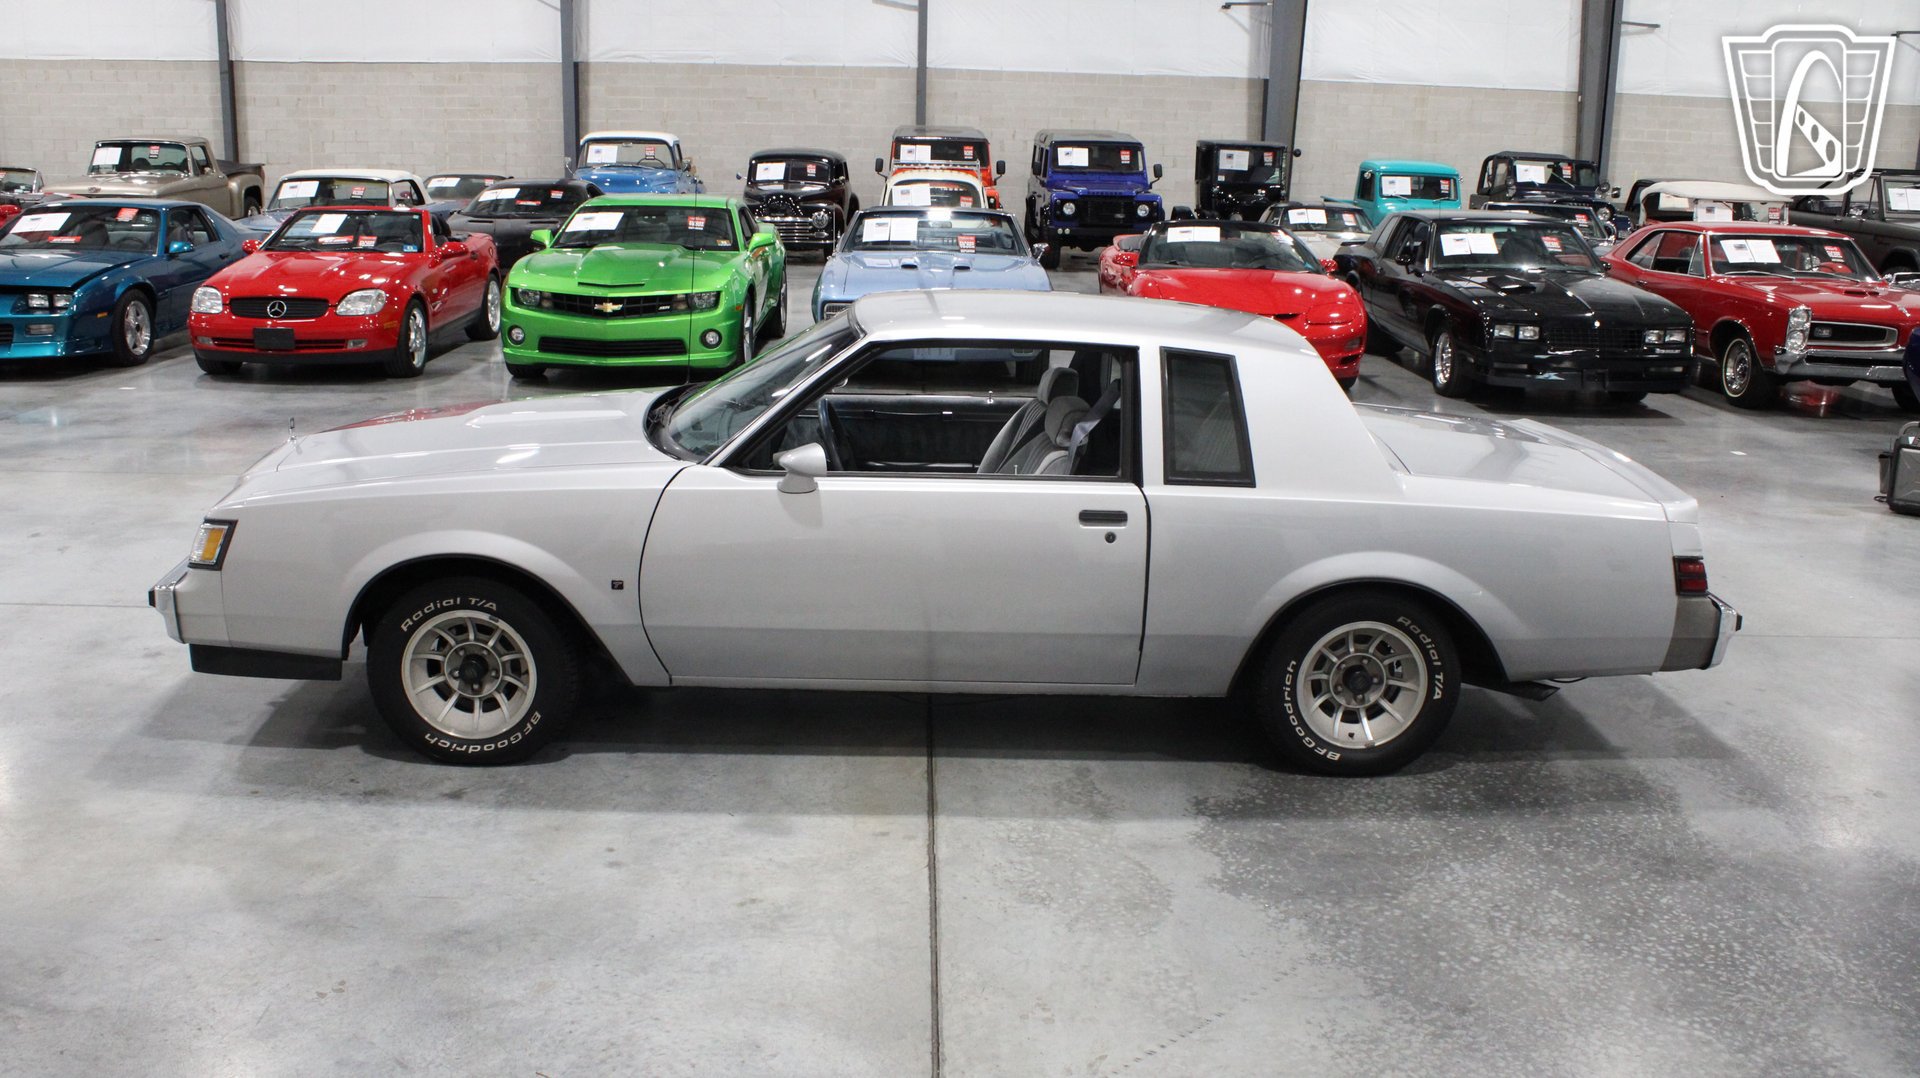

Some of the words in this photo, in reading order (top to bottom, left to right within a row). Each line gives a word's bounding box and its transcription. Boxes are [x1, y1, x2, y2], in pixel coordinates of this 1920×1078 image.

[400, 597, 460, 632] Radial
[468, 597, 498, 611] T/A
[1396, 615, 1442, 666] Radial
[1432, 672, 1444, 700] T/A
[424, 711, 541, 754] BFGoodrich
[1282, 660, 1341, 761] BFGoodrich
